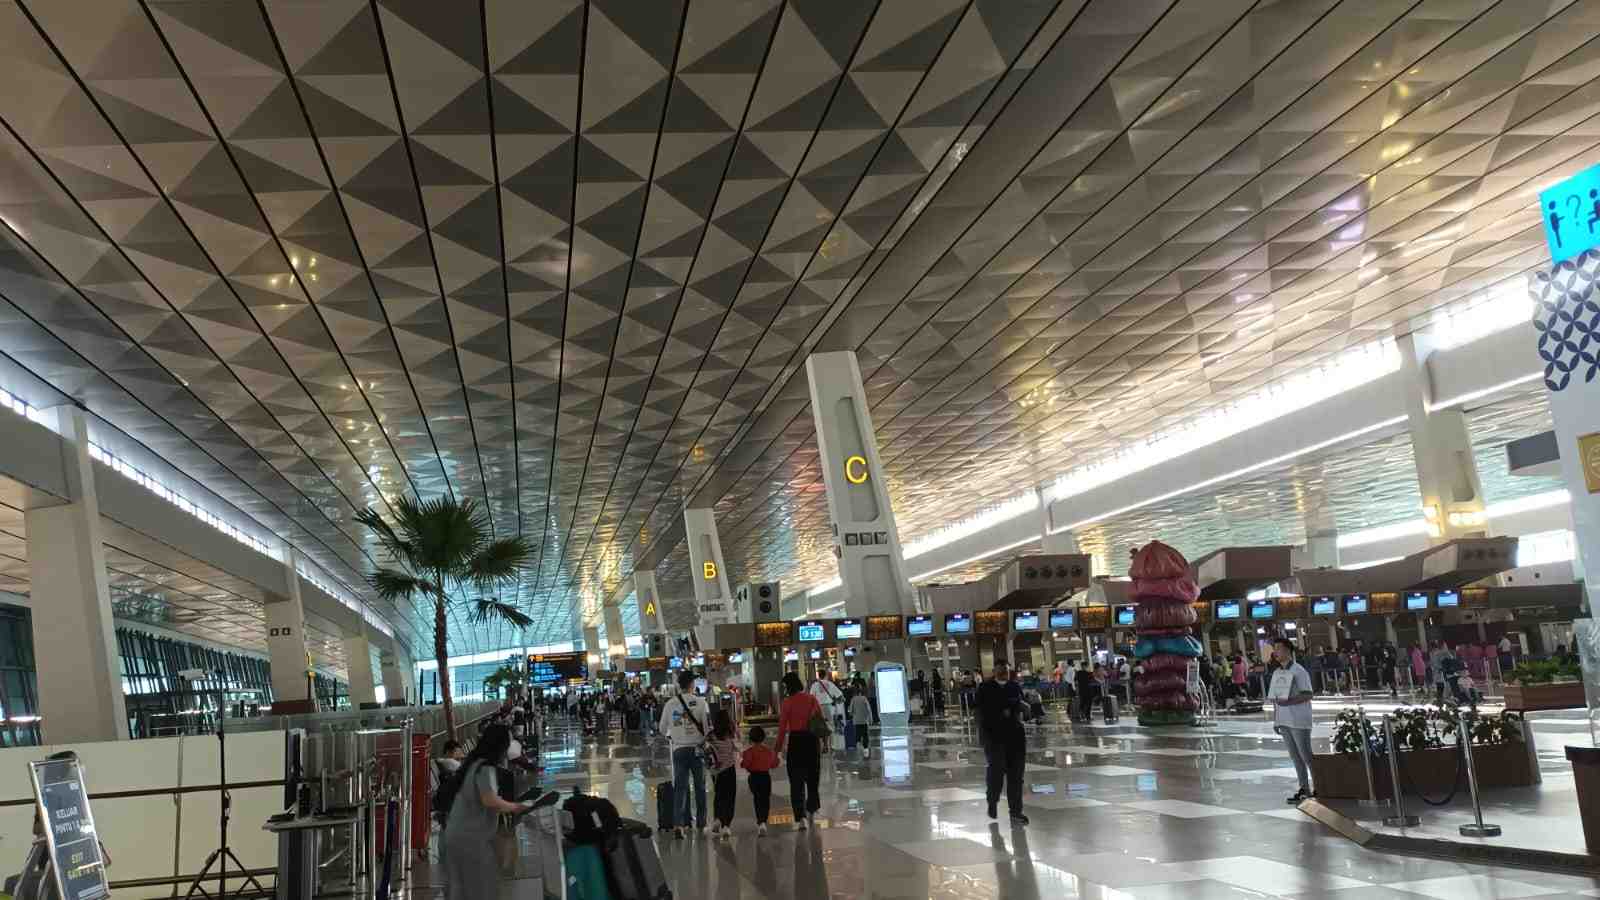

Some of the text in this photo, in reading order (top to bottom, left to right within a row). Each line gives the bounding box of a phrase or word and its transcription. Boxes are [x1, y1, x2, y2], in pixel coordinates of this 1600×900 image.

[846, 456, 868, 484] C
[703, 562, 717, 580] B
[645, 602, 656, 617] A
[71, 851, 84, 864] EXIT
